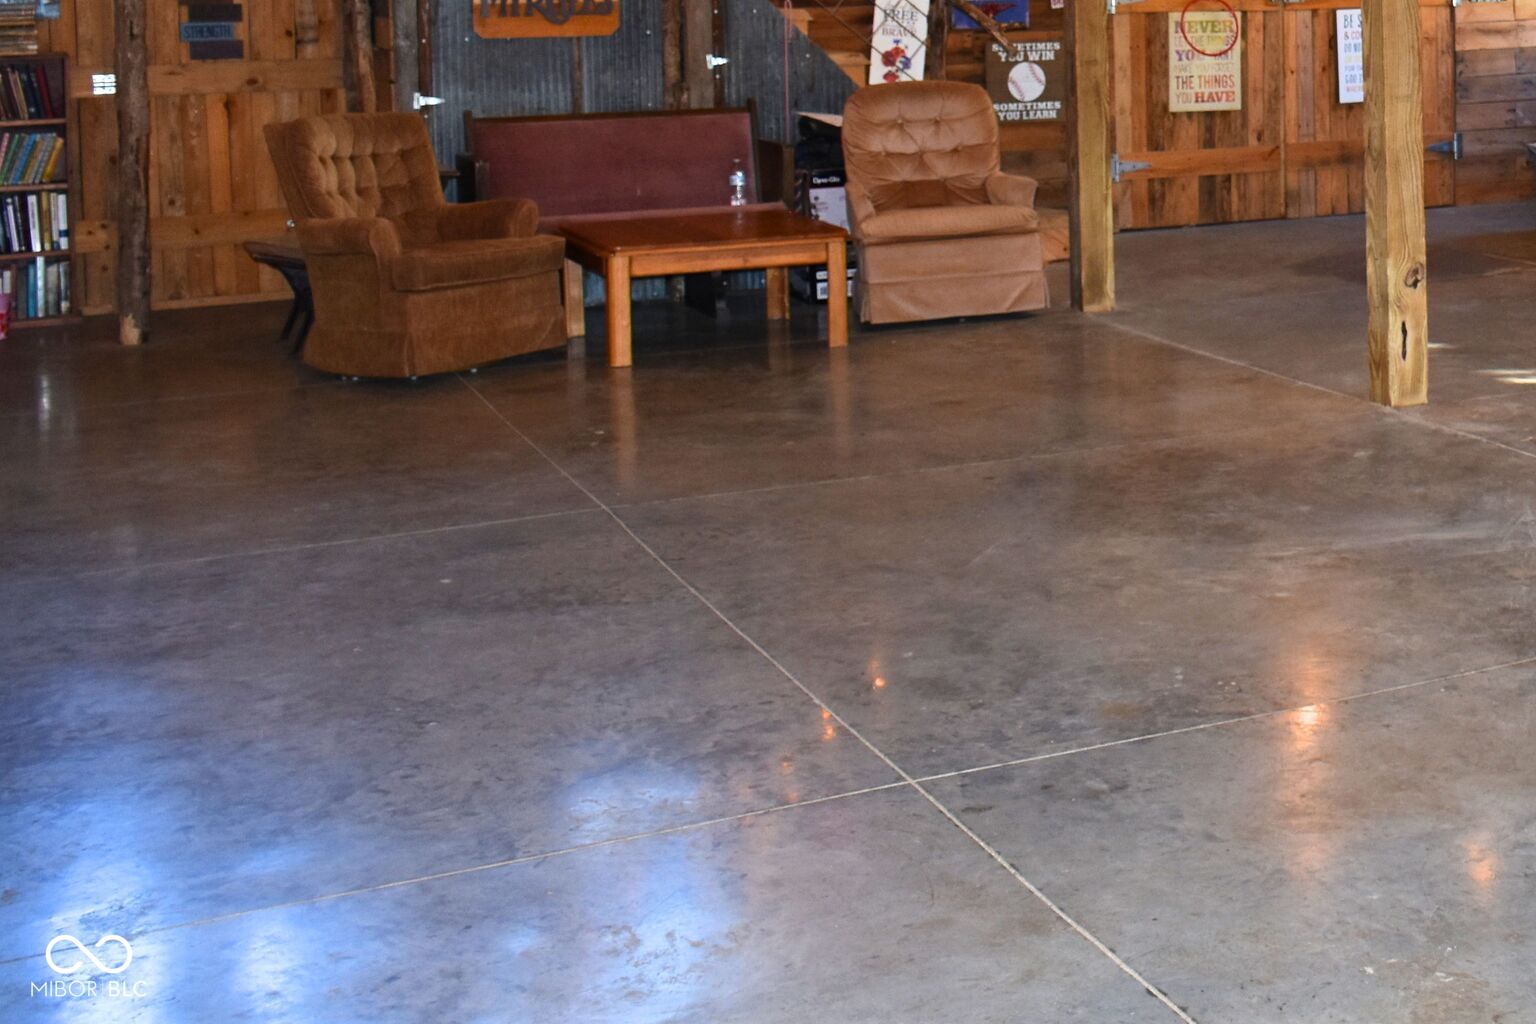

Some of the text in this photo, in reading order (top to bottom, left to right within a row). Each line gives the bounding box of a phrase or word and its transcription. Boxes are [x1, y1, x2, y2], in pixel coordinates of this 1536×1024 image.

[1344, 15, 1353, 28] BE
[1027, 51, 1055, 61] WIN
[1175, 75, 1235, 89] THE THINGS
[1176, 91, 1235, 104] YOU HAVE
[993, 102, 1061, 111] SOMETIMES
[998, 110, 1056, 120] YOU LEARN
